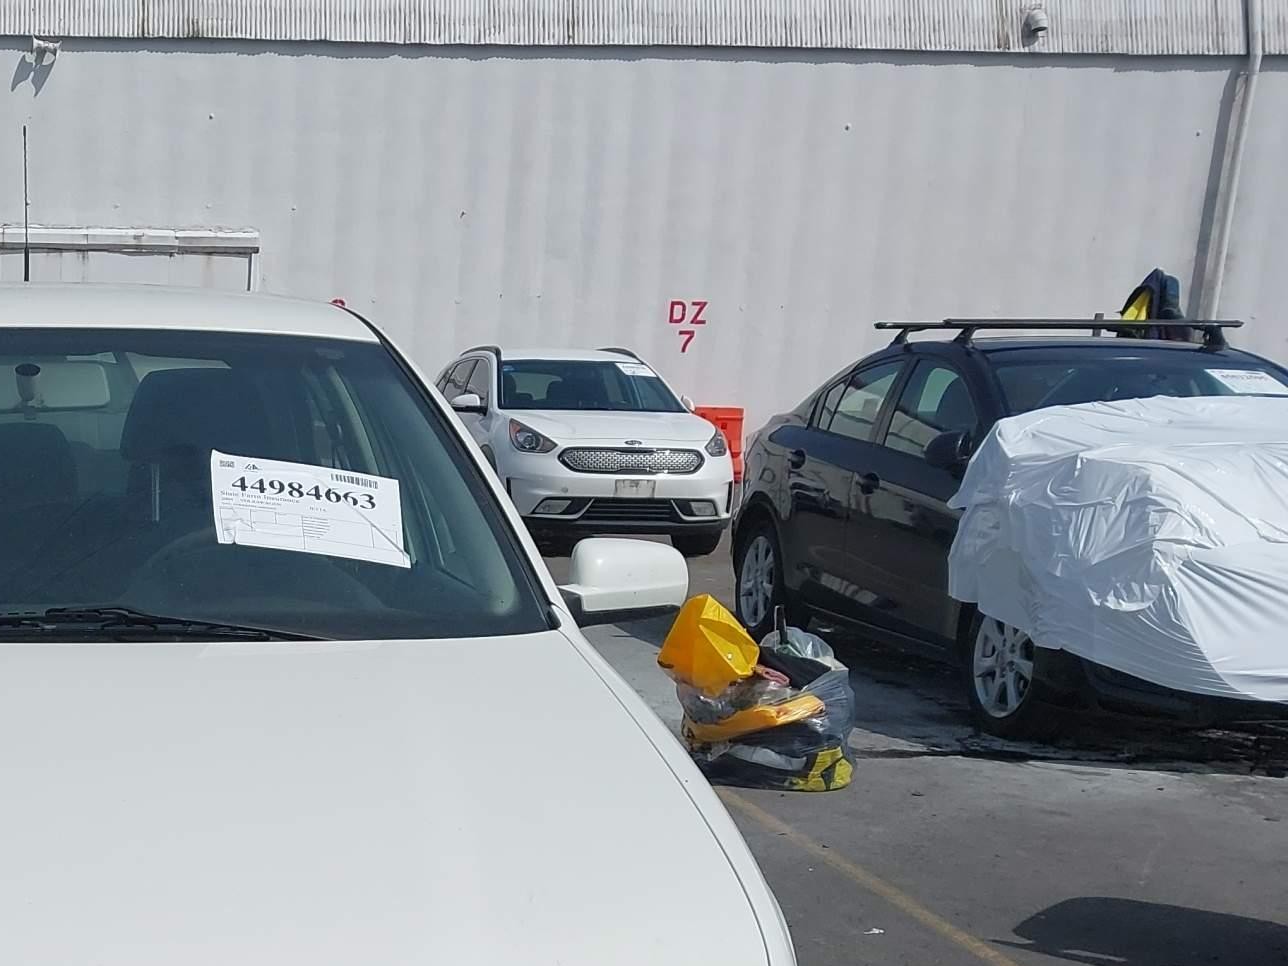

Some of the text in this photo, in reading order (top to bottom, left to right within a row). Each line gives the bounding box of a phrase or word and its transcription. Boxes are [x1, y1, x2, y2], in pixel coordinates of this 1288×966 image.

[668, 300, 708, 325] DZ
[678, 330, 695, 354] 7
[231, 475, 377, 510] 44984663
